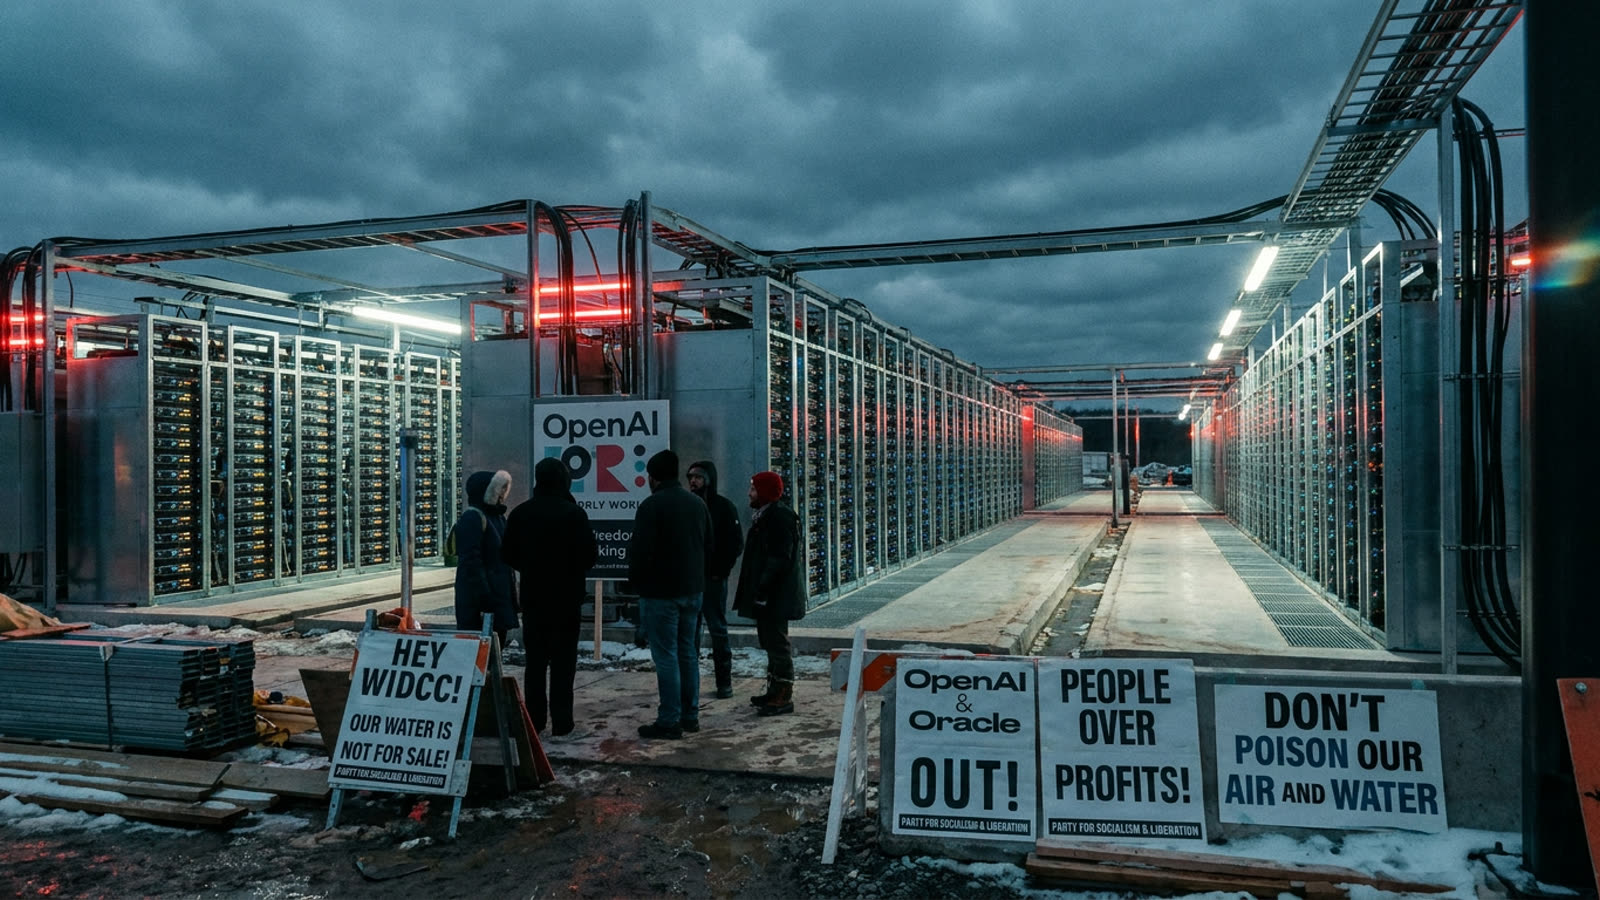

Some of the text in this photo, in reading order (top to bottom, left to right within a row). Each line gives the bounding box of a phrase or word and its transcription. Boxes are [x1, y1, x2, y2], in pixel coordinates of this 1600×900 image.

[543, 411, 658, 444] OpenAI
[592, 529, 633, 541] eedo
[391, 638, 447, 669] HEY
[361, 667, 463, 704] WIDCC!
[904, 668, 1027, 694] OpenAI
[1061, 668, 1172, 704] PEOPLE
[955, 693, 973, 713] &
[1264, 691, 1385, 733] DON'T
[350, 713, 453, 740] OUR WATER IS
[908, 710, 1021, 734] Oracle
[1079, 708, 1157, 746] OVER
[340, 740, 450, 769] NOT FOR SALE!
[1235, 735, 1424, 772] POISON OUR
[910, 756, 1018, 812] OUT!
[1055, 764, 1191, 804] PROFITS!
[1224, 774, 1439, 815] AIR AND WATER
[1052, 821, 1078, 832] PARTY
[1079, 822, 1095, 833] FOR
[1096, 823, 1140, 834] SOCIALISM
[1150, 825, 1199, 836] LIBERATION
